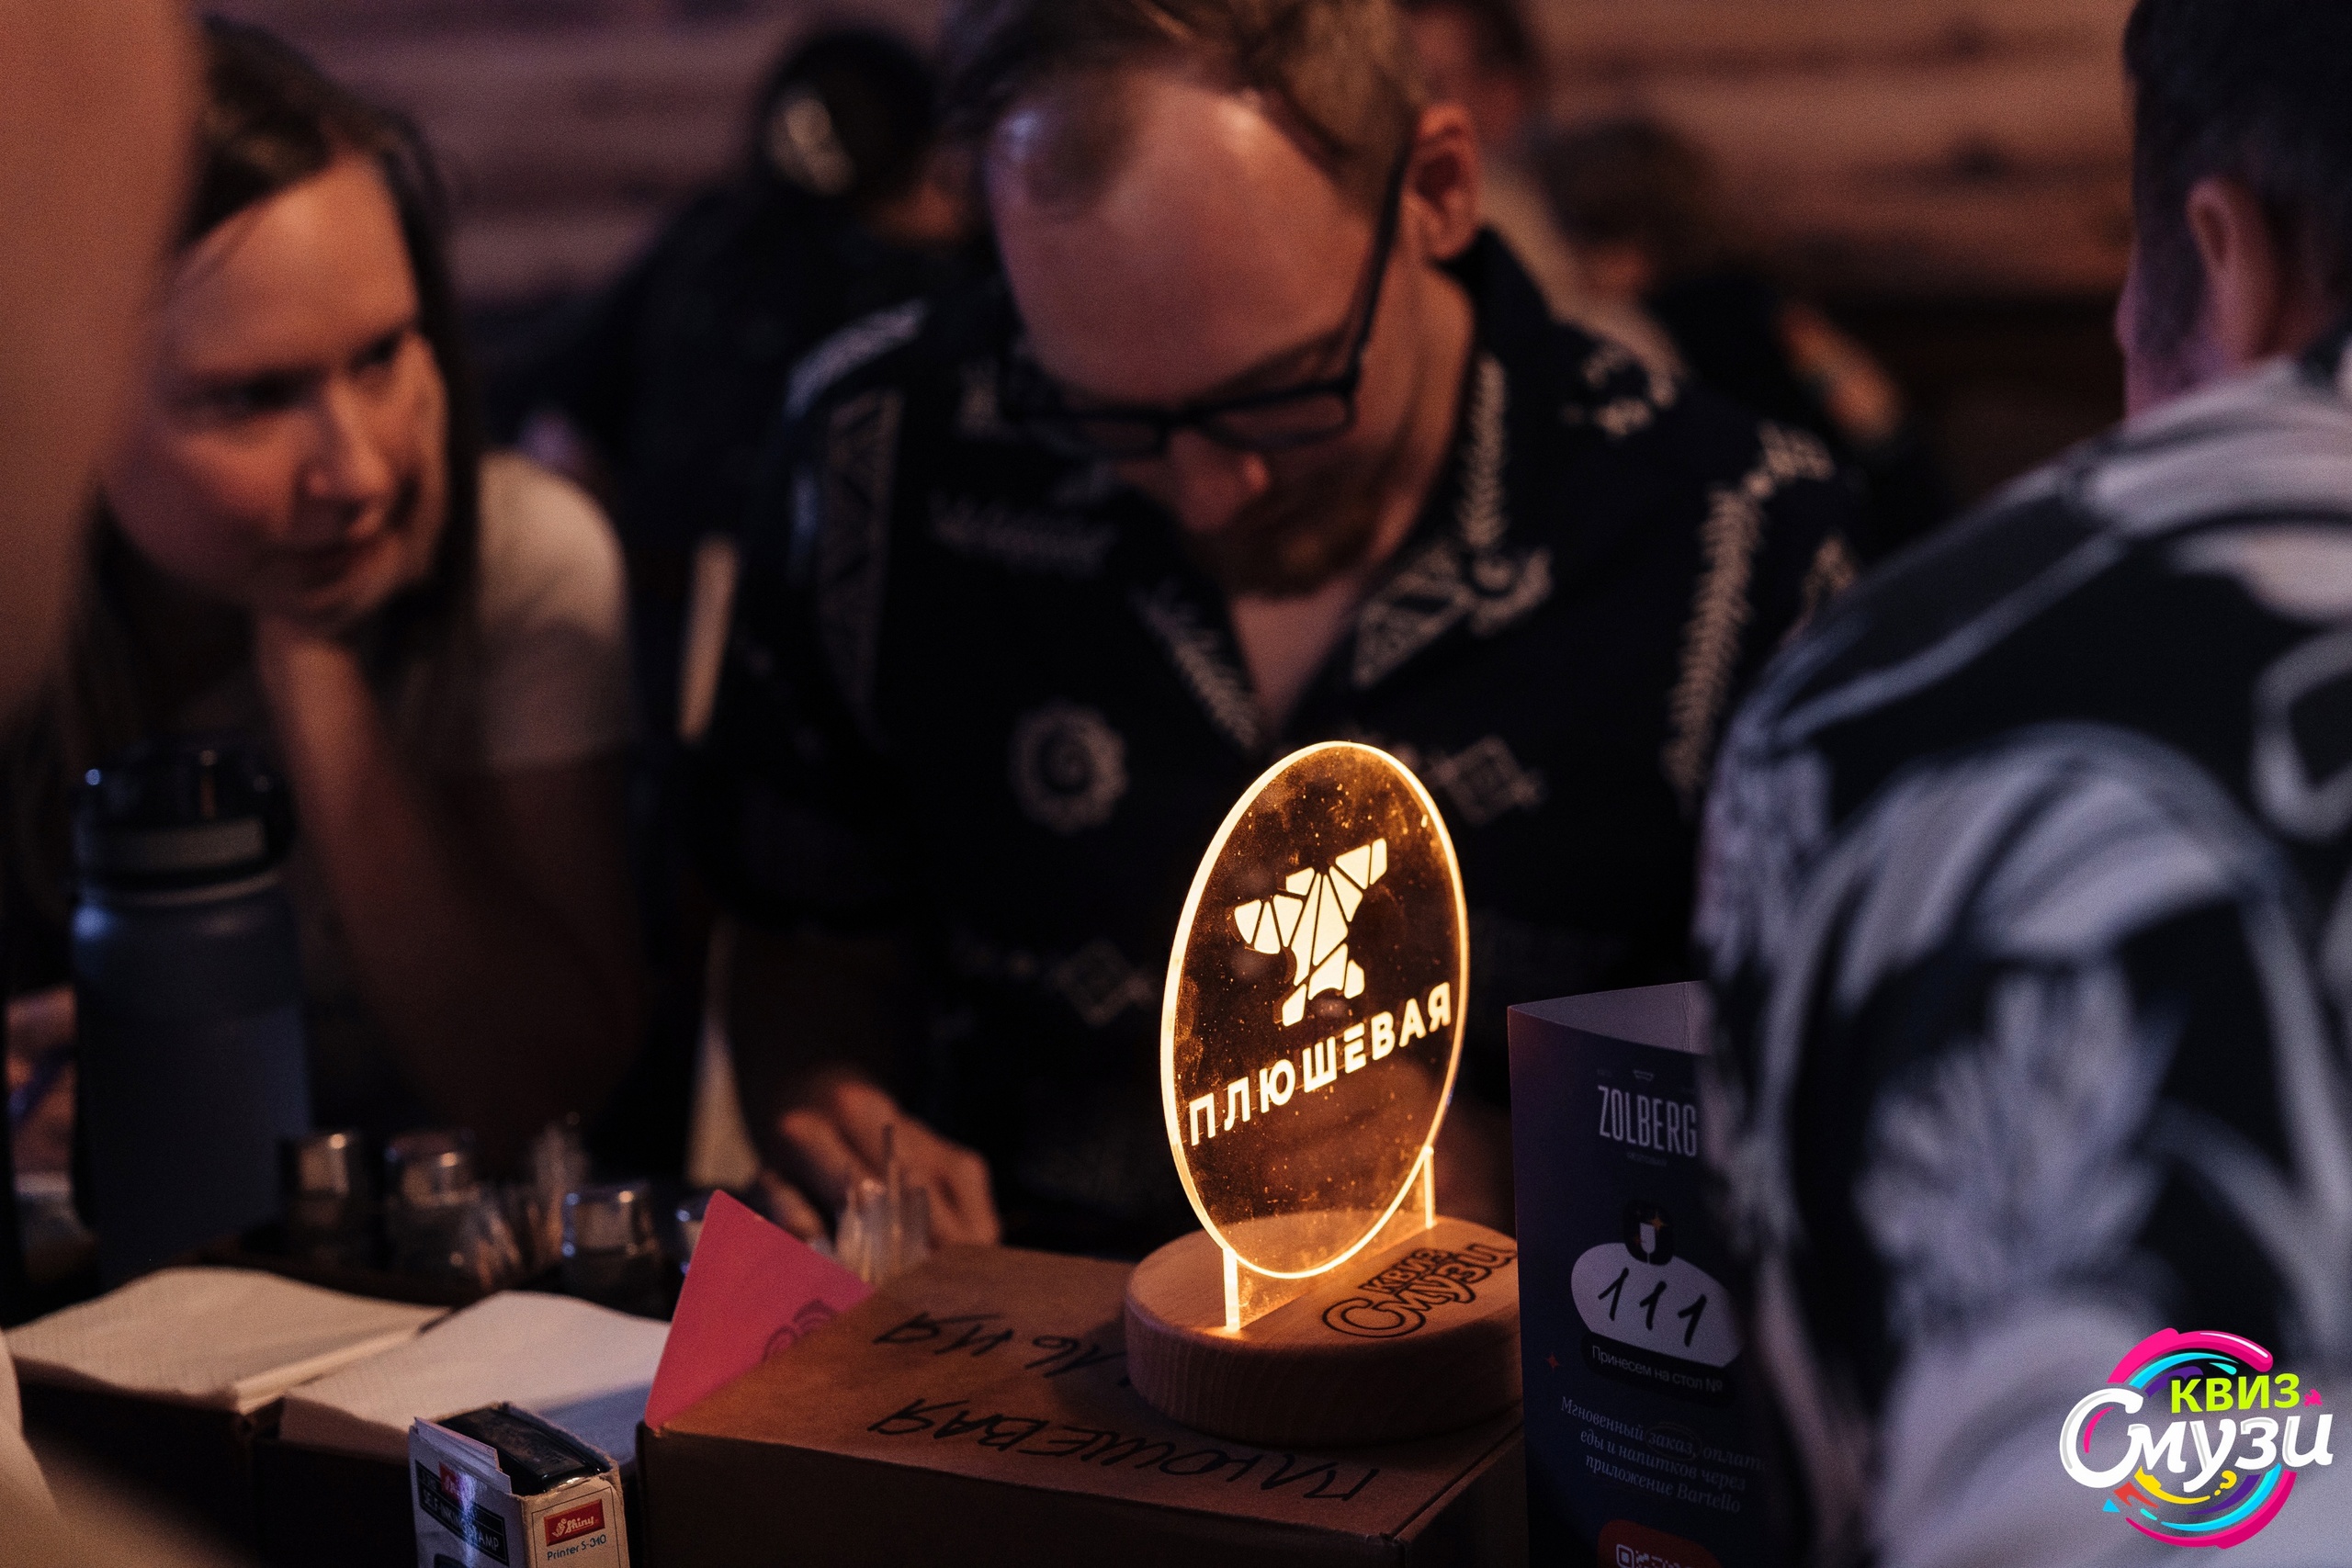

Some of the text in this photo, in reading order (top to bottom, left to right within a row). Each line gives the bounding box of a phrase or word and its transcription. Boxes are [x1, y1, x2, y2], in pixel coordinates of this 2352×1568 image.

[1188, 981, 1453, 1147] ПЛЮШЕВАЯ
[1597, 1084, 1698, 1158] ZOLBERG
[1321, 1242, 1518, 1338] Смузи
[1597, 1268, 1708, 1348] 111
[1591, 1344, 1652, 1378] Принесем
[1654, 1369, 1670, 1383] на
[1671, 1372, 1703, 1390] стол
[866, 1399, 1380, 1501] ПЛЮШЕВАЯ
[1560, 1395, 1765, 1472] Мгновенный заказ, оплат
[1579, 1427, 1747, 1493] еды и напитков через
[1585, 1453, 1742, 1514] приложение Bartello
[547, 1545, 580, 1561] Printer
[564, 1516, 594, 1535] Shiny
